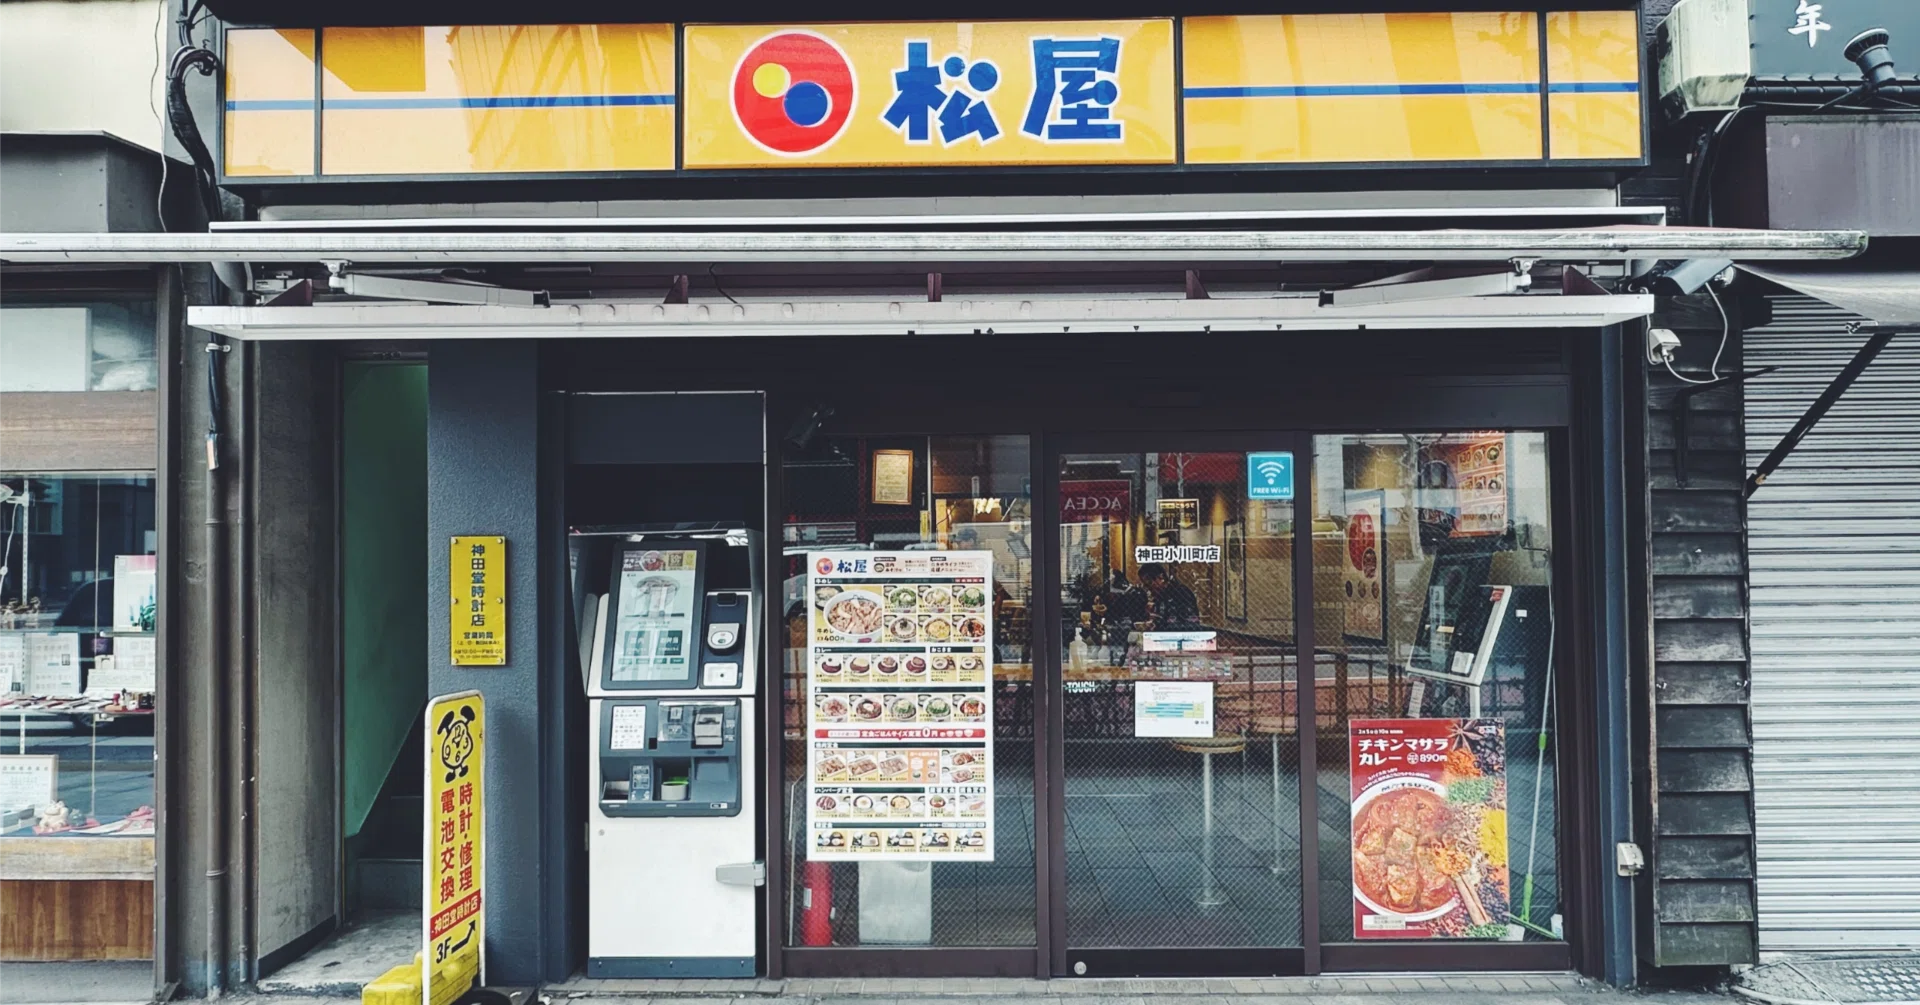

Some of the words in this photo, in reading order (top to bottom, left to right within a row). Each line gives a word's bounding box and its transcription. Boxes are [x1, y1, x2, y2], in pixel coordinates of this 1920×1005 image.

[1787, 3, 1832, 48] 年
[883, 37, 1126, 145] 松屋
[837, 559, 868, 574] 松屋
[1137, 547, 1219, 562] 神田小川町店
[471, 544, 485, 626] 神田堂時計店
[1066, 681, 1095, 693] TOUCH
[1358, 738, 1449, 752] チキンマサラ
[1358, 752, 1402, 766] カレー
[1420, 753, 1448, 763] 890円
[440, 788, 455, 905] 電池交換
[459, 782, 473, 892] 時計・修理
[436, 935, 452, 964] 3F
